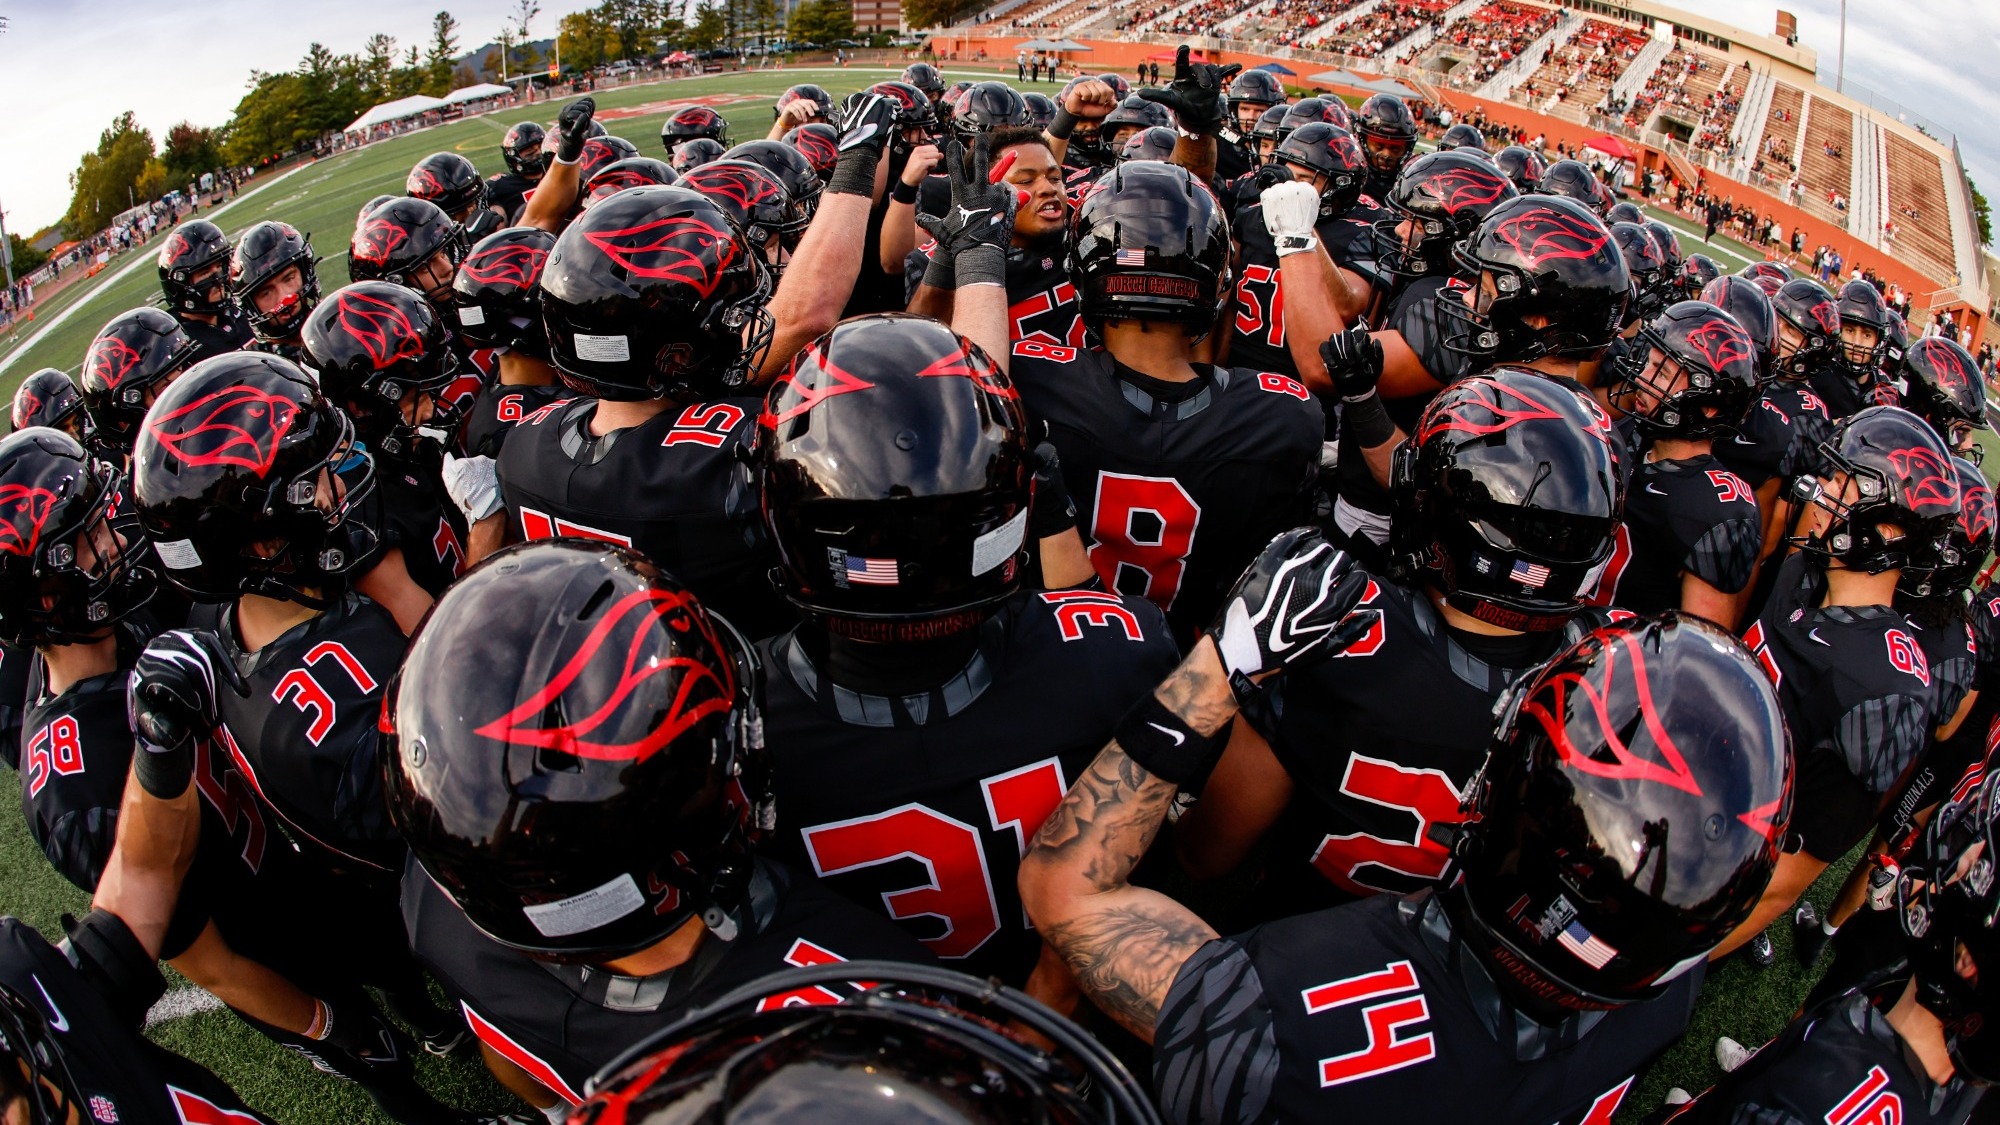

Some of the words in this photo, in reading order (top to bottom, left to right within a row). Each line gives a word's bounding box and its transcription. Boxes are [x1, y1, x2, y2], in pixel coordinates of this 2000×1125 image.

[1218, 126, 1241, 144] NIKE
[1282, 236, 1310, 249] NIKE
[1105, 276, 1147, 293] NORTH
[1149, 277, 1200, 298] CENTRAL
[1235, 264, 1286, 348] 51
[1012, 340, 1077, 363] 8
[1257, 372, 1311, 401] 8
[661, 402, 746, 449] 15
[1086, 470, 1201, 611] 8
[1038, 589, 1144, 643] 31
[1471, 599, 1531, 631] NORTH
[1884, 628, 1931, 688] 69
[271, 640, 379, 748] 37
[28, 714, 86, 800] 58
[1893, 767, 1936, 829] CARDINALS
[801, 756, 1068, 959] 31
[557, 891, 600, 909] WARNING
[1301, 960, 1437, 1088] 14
